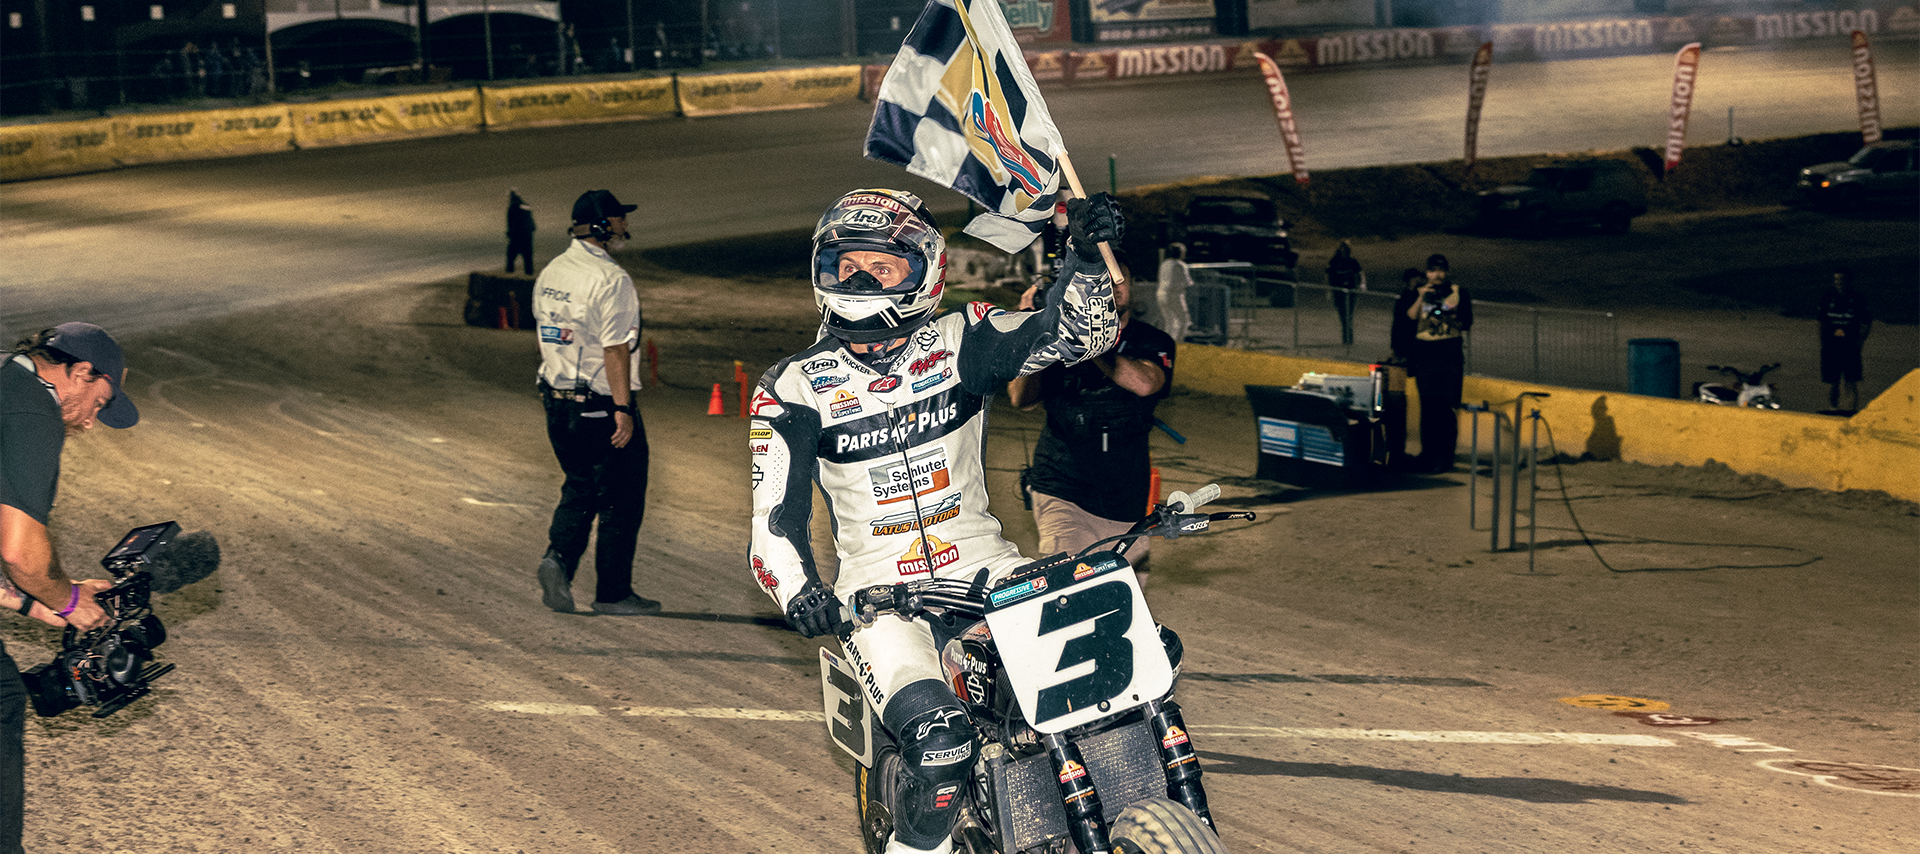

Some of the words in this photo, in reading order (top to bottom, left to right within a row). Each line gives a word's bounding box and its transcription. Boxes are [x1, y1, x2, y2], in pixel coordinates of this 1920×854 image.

[844, 357, 871, 375] KICKER
[837, 427, 889, 453] PARTS
[918, 403, 957, 432] PLUS
[892, 458, 947, 482] Schluter
[874, 476, 930, 498] Systems
[872, 521, 912, 537] LATUS
[912, 505, 961, 531] MOTORS
[994, 583, 1031, 601] PROGRESSIVE
[843, 633, 862, 666] PARTS
[1035, 581, 1133, 726] 3
[970, 656, 987, 675] PLUS
[865, 672, 884, 705] PLUS
[829, 663, 866, 757] 3
[923, 742, 971, 762] SERVICE
